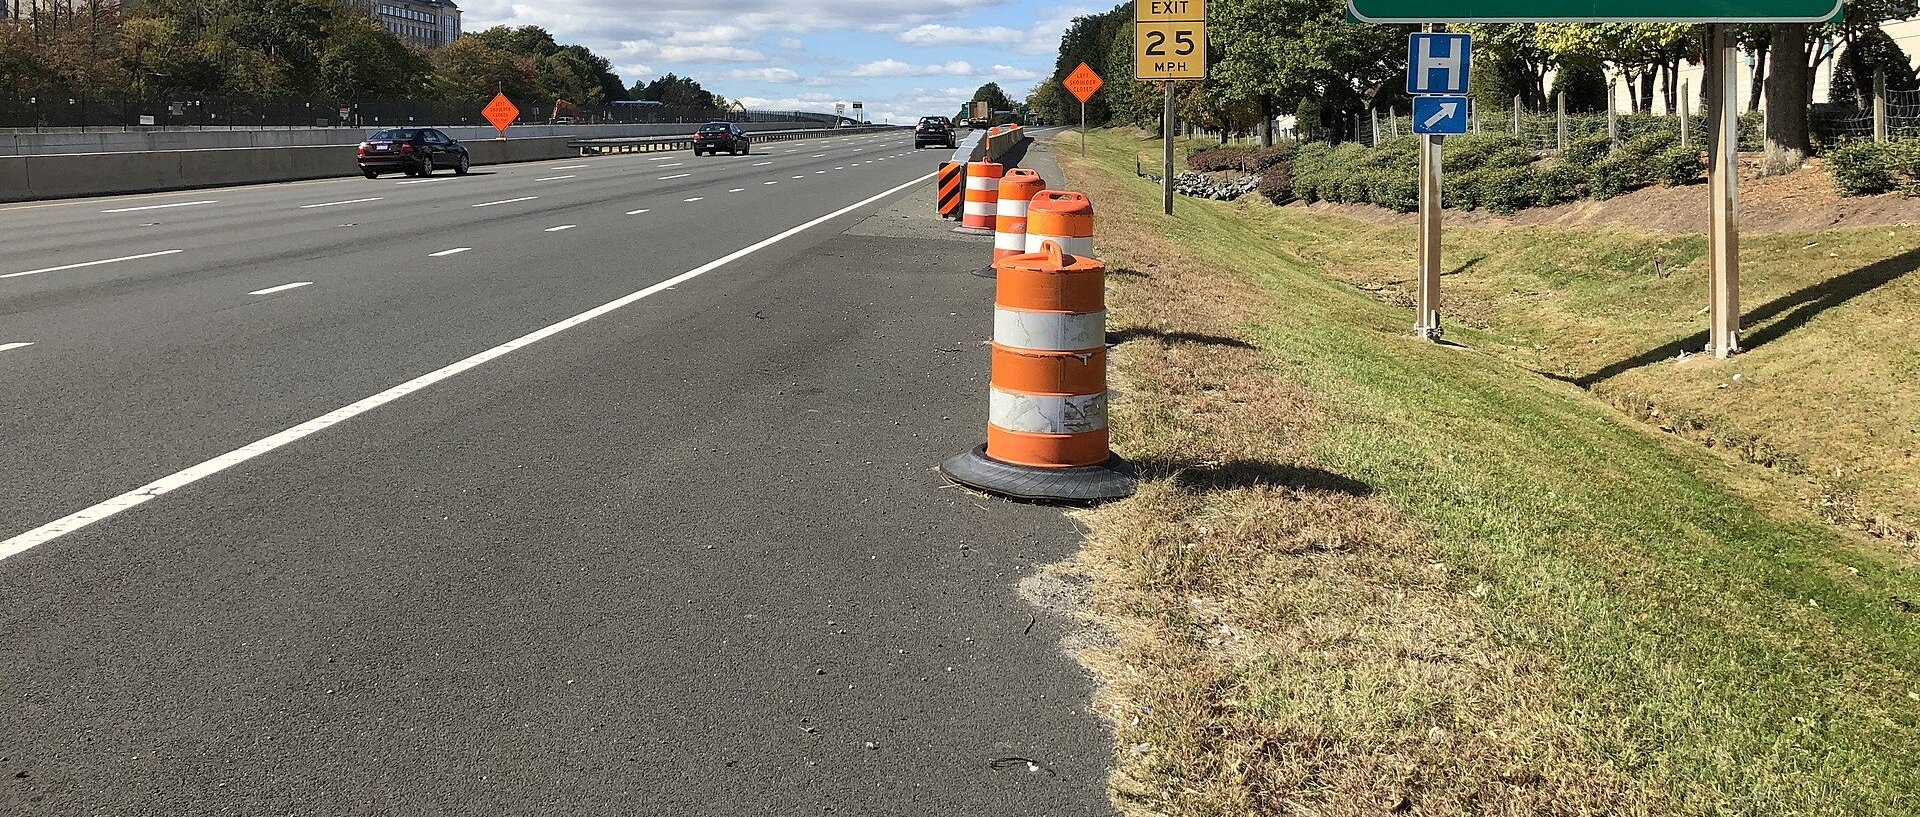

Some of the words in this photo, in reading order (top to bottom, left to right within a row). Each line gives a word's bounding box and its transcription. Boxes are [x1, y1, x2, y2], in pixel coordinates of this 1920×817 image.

[1152, 1, 1188, 14] EXIT
[1145, 31, 1195, 55] 25
[1154, 62, 1188, 72] M.P.H.
[1417, 38, 1462, 90] H
